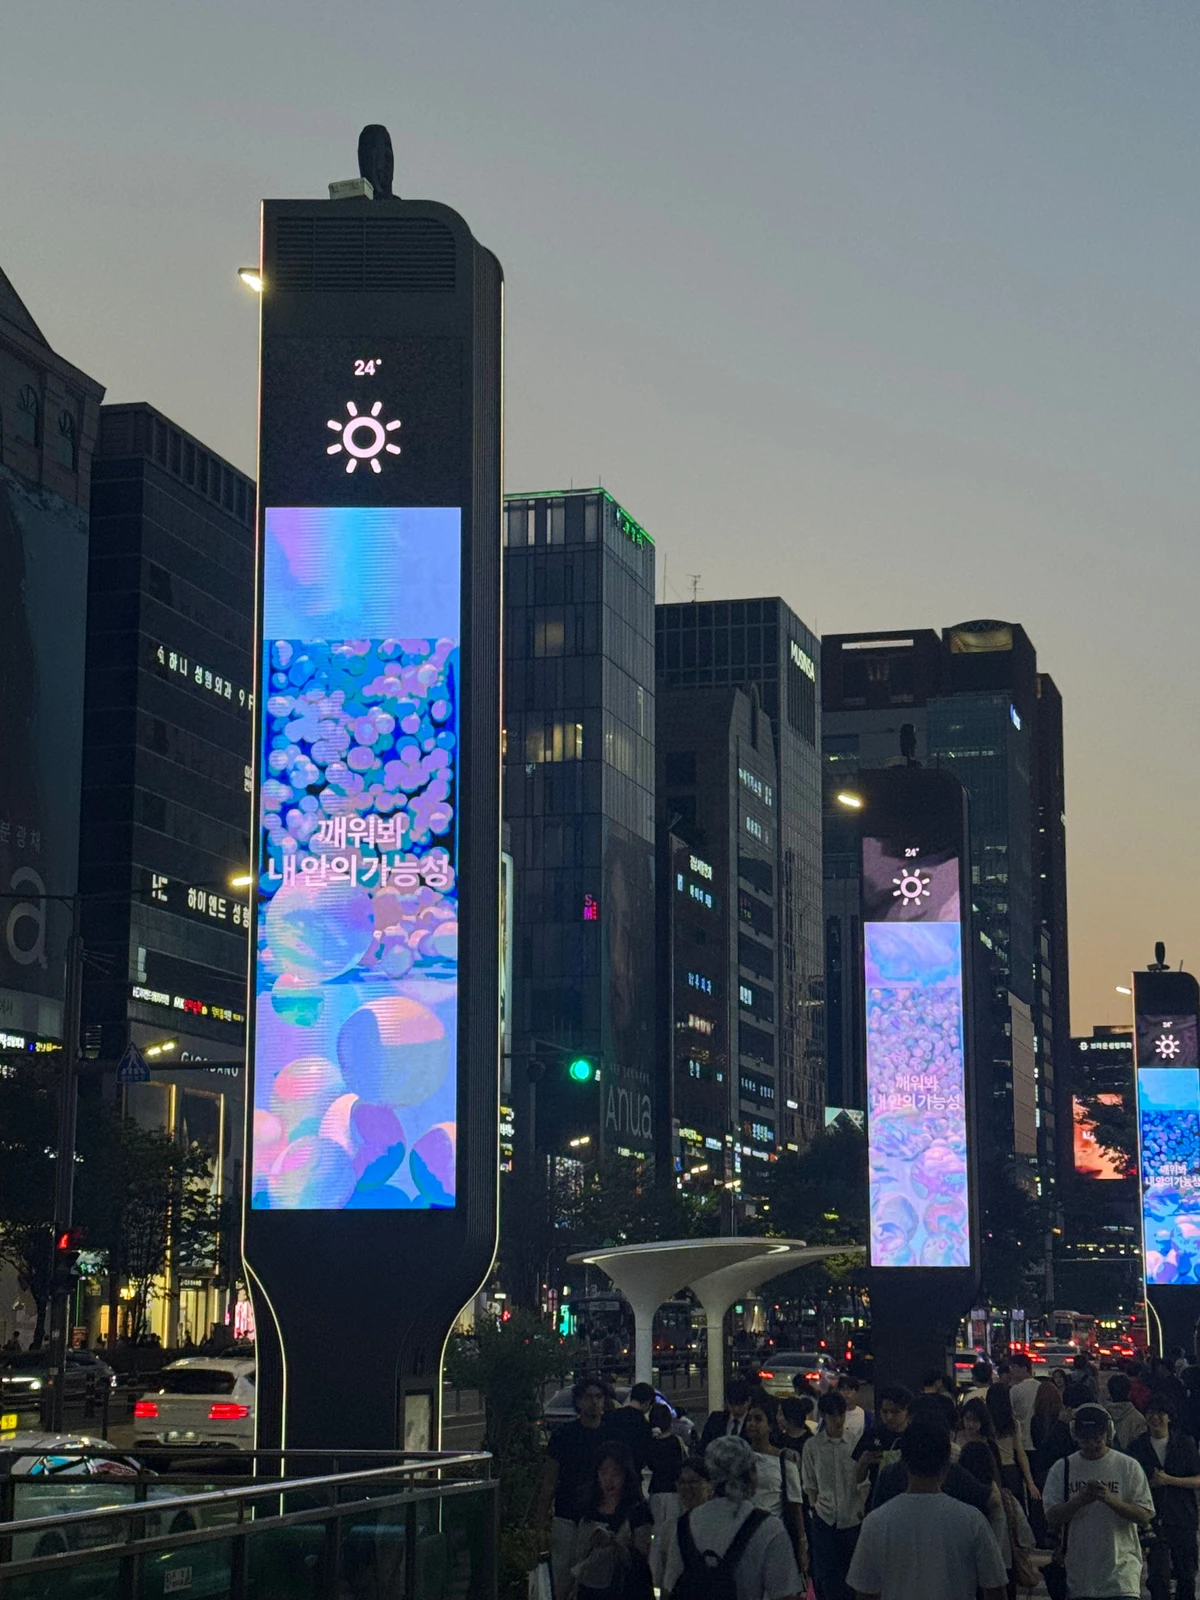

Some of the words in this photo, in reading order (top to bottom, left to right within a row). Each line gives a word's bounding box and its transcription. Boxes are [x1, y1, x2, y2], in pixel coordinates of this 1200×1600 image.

[353, 358, 383, 376] 24°
[168, 651, 188, 677] 하니
[193, 665, 232, 700] 성형외과
[316, 816, 406, 850] 깨워봐
[904, 847, 920, 858] 24°
[267, 853, 297, 888] 내
[299, 853, 358, 888] 안의
[361, 853, 450, 888] 가능성
[187, 887, 227, 920] 하이엔드
[895, 1074, 940, 1092] 깨워봐
[605, 1083, 653, 1141] Anua
[917, 1093, 961, 1111] 가능성
